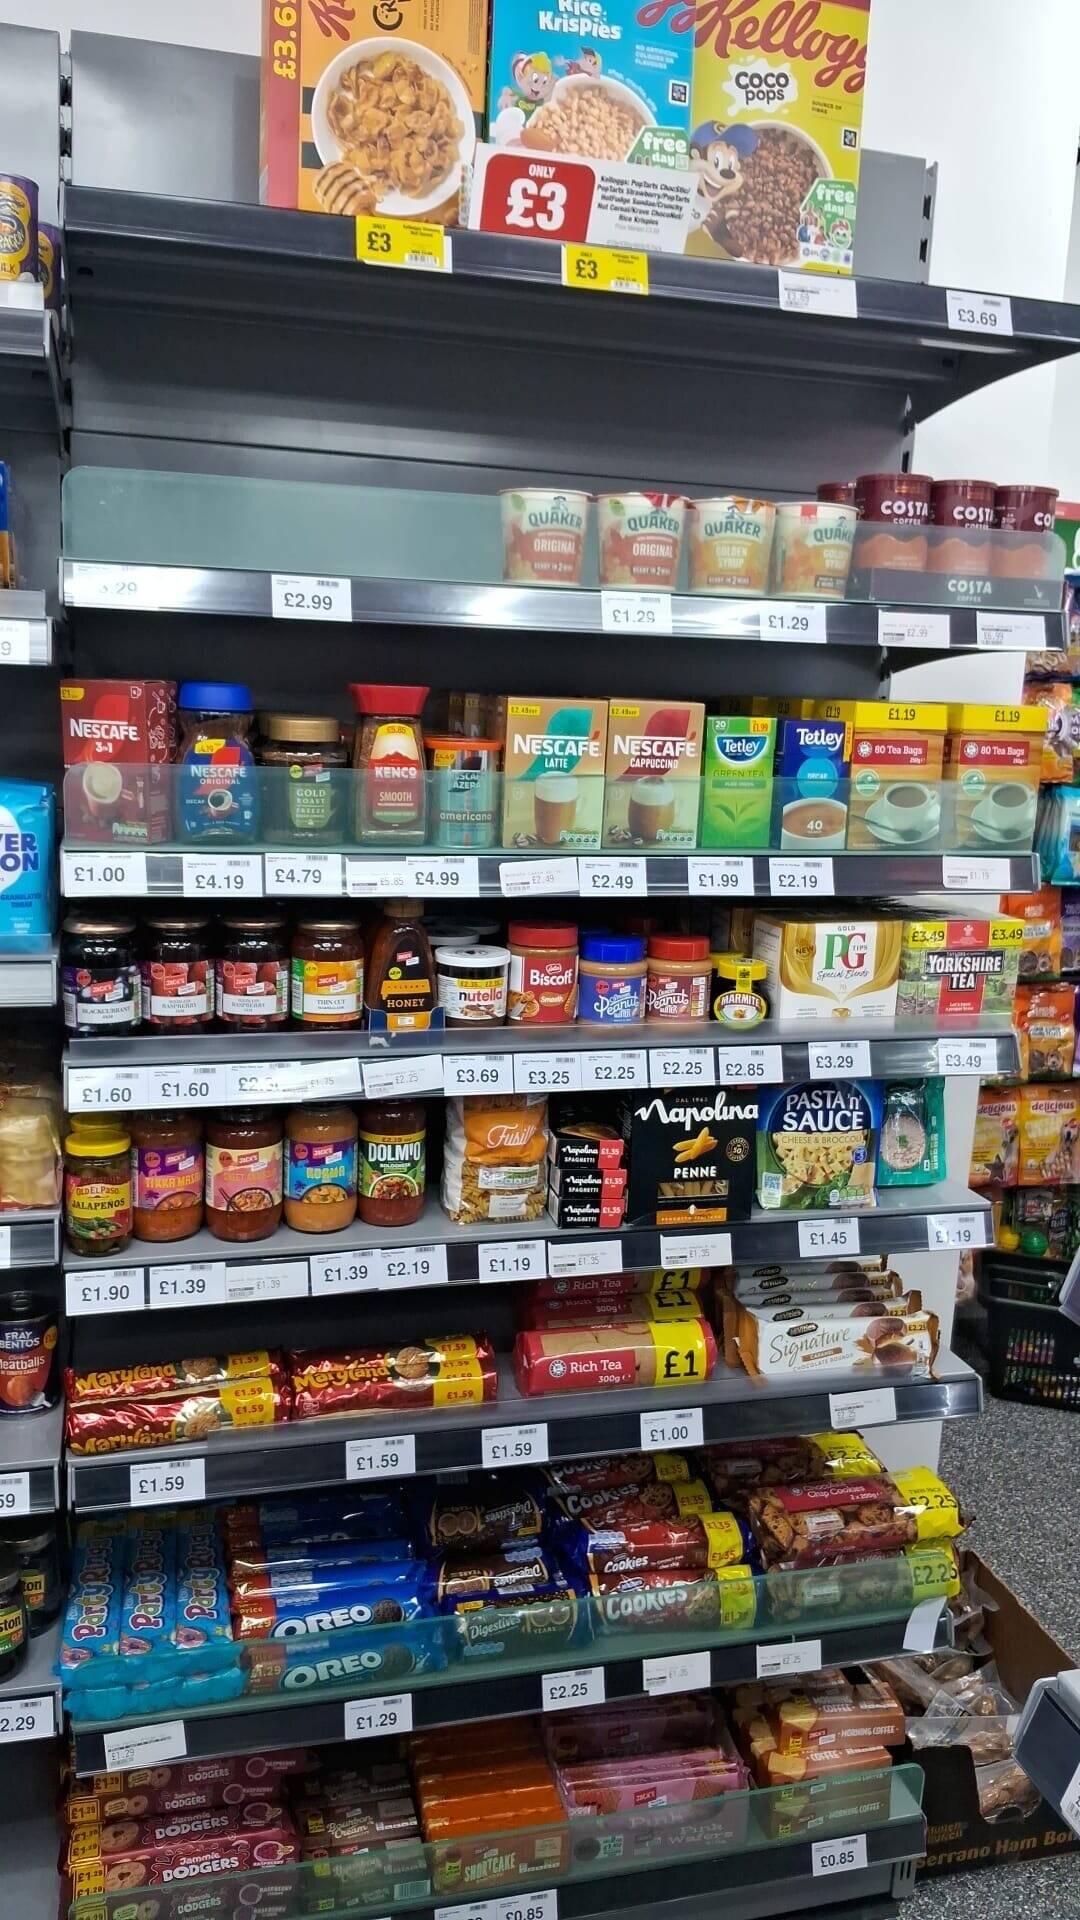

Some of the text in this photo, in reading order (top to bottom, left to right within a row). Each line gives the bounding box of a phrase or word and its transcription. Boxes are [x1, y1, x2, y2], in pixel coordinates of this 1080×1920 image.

[559, 0, 602, 16] Rice
[539, 11, 622, 39] Krispies
[745, 81, 785, 104] pops
[642, 135, 686, 154] free
[652, 151, 675, 167] day
[529, 163, 554, 177] ONLY
[816, 183, 854, 202] free
[506, 178, 567, 230] £3
[824, 203, 844, 217] day
[367, 231, 391, 253] £3
[575, 258, 598, 279] £3
[957, 308, 998, 327] £3.69
[880, 500, 929, 517] COSTA
[528, 511, 583, 530] QUAKER
[627, 515, 679, 534] QUAKER
[704, 520, 761, 537] QUAKER
[534, 537, 576, 554] ORIGINAL
[633, 542, 673, 557] ORIGINAL
[947, 579, 991, 595] COSTA
[284, 591, 334, 610] £2.99
[613, 609, 655, 623] £1.29
[768, 615, 808, 630] £1.29
[887, 707, 916, 721] £1.19
[994, 709, 1019, 722] £1.19
[722, 738, 760, 756] Tetley
[796, 728, 843, 750] Tetley
[874, 745, 923, 758] 80 Tea Bags
[979, 745, 1025, 759] 80 Tea Bags
[544, 756, 568, 769] LATTE
[630, 757, 679, 769] CAPPUCCINO
[374, 766, 417, 779] KENCO
[713, 768, 744, 778] GREEN
[199, 777, 241, 785] ORIGINAL
[296, 788, 327, 798] GOLD
[379, 791, 412, 803] SMOOTH
[440, 810, 492, 823] americano
[806, 819, 823, 830] 40
[74, 867, 125, 882] £1.00
[194, 874, 244, 889] £4.19
[275, 867, 322, 883] £4.79
[415, 872, 459, 886] £4.99
[591, 874, 633, 889] £2.49
[698, 873, 740, 887] £1.99
[778, 874, 818, 888] £2.19
[911, 929, 944, 942] £3.49
[991, 928, 1023, 940] £3.49
[795, 947, 814, 955] NEW
[822, 932, 866, 971] PG
[853, 944, 868, 952] TIPS
[927, 953, 1002, 973] YORKSHIRE
[530, 969, 573, 987] Biscoff
[815, 967, 842, 980] Special
[951, 972, 974, 989] TEA
[386, 997, 425, 1007] HONEY
[458, 987, 503, 1002] nutella
[645, 989, 688, 1009] Peanut
[720, 995, 761, 1007] MARMITE
[82, 1005, 131, 1016] BLACKCURRANT
[594, 993, 639, 1017] Peanut
[662, 1061, 703, 1076] £2.25
[816, 1055, 853, 1069] £3.29
[945, 1055, 982, 1068] £3.49
[456, 1068, 499, 1083] £3.69
[528, 1070, 570, 1085] £3.25
[594, 1066, 636, 1081] £2.25
[725, 1063, 765, 1077] £2.85
[82, 1087, 131, 1103] £1.60
[161, 1081, 209, 1097] £1.60
[786, 1090, 846, 1110] PASTA
[1031, 1100, 1074, 1114] delicious
[634, 1089, 759, 1131] Napolina
[978, 1102, 1016, 1115] delicious
[782, 1111, 863, 1131] SAUCE
[781, 1134, 811, 1144] CHEESE
[813, 1135, 820, 1144] &
[368, 1141, 421, 1162] DOLMIO
[561, 1143, 599, 1156] Napolina
[600, 1146, 620, 1156] £1.35
[564, 1156, 596, 1164] SPAGHETTI
[673, 1164, 716, 1179] PENNE
[763, 1173, 780, 1181] LOW
[565, 1175, 601, 1186] Napolina
[604, 1175, 623, 1186] £1.35
[764, 1180, 780, 1189] FAT
[568, 1185, 599, 1193] SPAGHETTI
[563, 1204, 600, 1215] Napolina
[602, 1204, 621, 1215] £1.35
[566, 1214, 597, 1222] SPAGHETTI
[809, 1231, 846, 1246] £1.45
[934, 1229, 970, 1243] £1.19
[387, 1260, 430, 1276] £2.19
[489, 1256, 531, 1272] £1.19
[324, 1265, 368, 1283] £1.39
[660, 1269, 689, 1291] £1
[159, 1279, 206, 1295] £1.39
[573, 1276, 622, 1290] Rich Tea
[81, 1285, 129, 1302] £1.90
[5, 1330, 32, 1341] FRAY
[441, 1341, 467, 1353] £1.59
[769, 1327, 850, 1365] Signature
[231, 1353, 259, 1366] £1.59
[570, 1358, 621, 1372] Rich Tea
[663, 1349, 699, 1379] £1
[75, 1360, 176, 1395] Maryland
[293, 1354, 389, 1392] Maryland
[599, 1372, 620, 1384] 300g
[233, 1385, 263, 1397] £1.59
[446, 1388, 474, 1401] £1.59
[235, 1403, 264, 1415] £1.59
[71, 1422, 177, 1455] Maryland
[650, 1424, 688, 1442] £1.00
[491, 1441, 533, 1459] £1.59
[355, 1452, 398, 1474] £1.59
[138, 1474, 185, 1494] £1.59
[566, 1483, 640, 1514] Cookies
[604, 1555, 649, 1573] Cookies
[913, 1560, 958, 1586] £2.25
[185, 1565, 217, 1621] Party
[130, 1571, 168, 1632] Party
[606, 1584, 689, 1619] Cookies
[72, 1583, 114, 1642] Party
[273, 1602, 374, 1637] OREO
[470, 1614, 521, 1641] Digestives
[281, 1650, 384, 1691] OREO
[548, 1682, 587, 1700] £2.25
[822, 1702, 853, 1714] COFFEE
[355, 1711, 397, 1730] £1.29
[841, 1724, 896, 1738] MORNING COFFEE
[810, 1749, 839, 1762] COFFEE
[188, 1766, 230, 1782] DODGERS
[164, 1794, 207, 1810] DODGERS
[155, 1814, 229, 1841] DODGERS
[333, 1825, 368, 1841] Cream
[178, 1850, 220, 1866] Jammie
[820, 1850, 855, 1868] £0.85
[915, 1836, 1038, 1869] Serrano Ham
[163, 1855, 239, 1882] DODGERS
[464, 1851, 516, 1882] SHORTCAKE
[177, 1894, 222, 1915] DODGERS
[505, 1904, 544, 1920] £0.85
